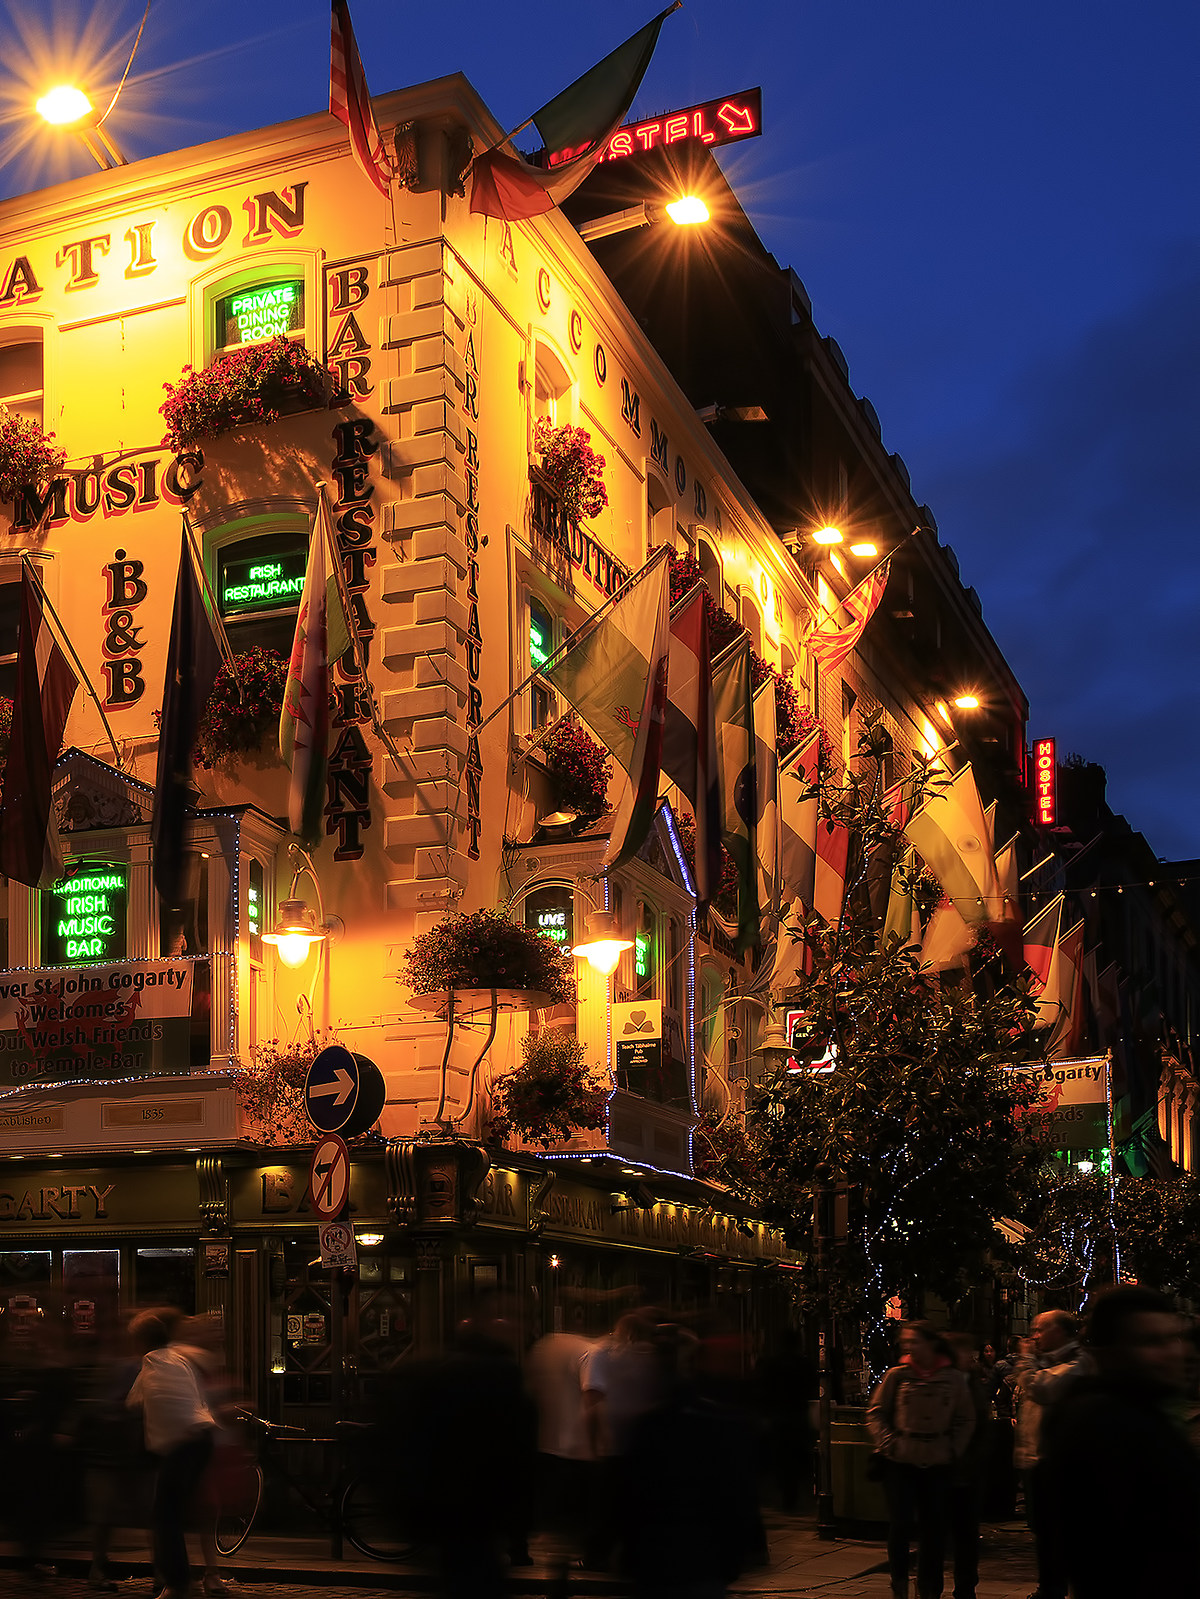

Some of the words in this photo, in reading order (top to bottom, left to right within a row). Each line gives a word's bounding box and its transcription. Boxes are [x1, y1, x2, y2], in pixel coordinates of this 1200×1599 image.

[232, 287, 294, 316] PRIVATE
[238, 304, 289, 329] DINING
[240, 320, 287, 343] ROOM
[327, 266, 375, 403] BAR
[8, 452, 205, 535] MUSIC
[249, 563, 282, 580] IRISH
[224, 577, 307, 602] RESTAURANT
[100, 552, 148, 713] B&B
[1038, 742, 1052, 823] HOSTEL
[53, 876, 125, 895] ADITIONAL
[66, 894, 107, 915] IRISH
[58, 915, 114, 937] MUSIC
[538, 912, 566, 926] LIVE
[66, 938, 104, 958] BAR
[108, 967, 188, 993] Gogarty
[30, 1000, 126, 1023] Welcomes
[31, 1027, 90, 1049] Welsh
[93, 1020, 164, 1044] Friends
[10, 1060, 29, 1077] to
[34, 1053, 105, 1076] Temple
[110, 1051, 144, 1070] Bar
[141, 1108, 166, 1121] 1835
